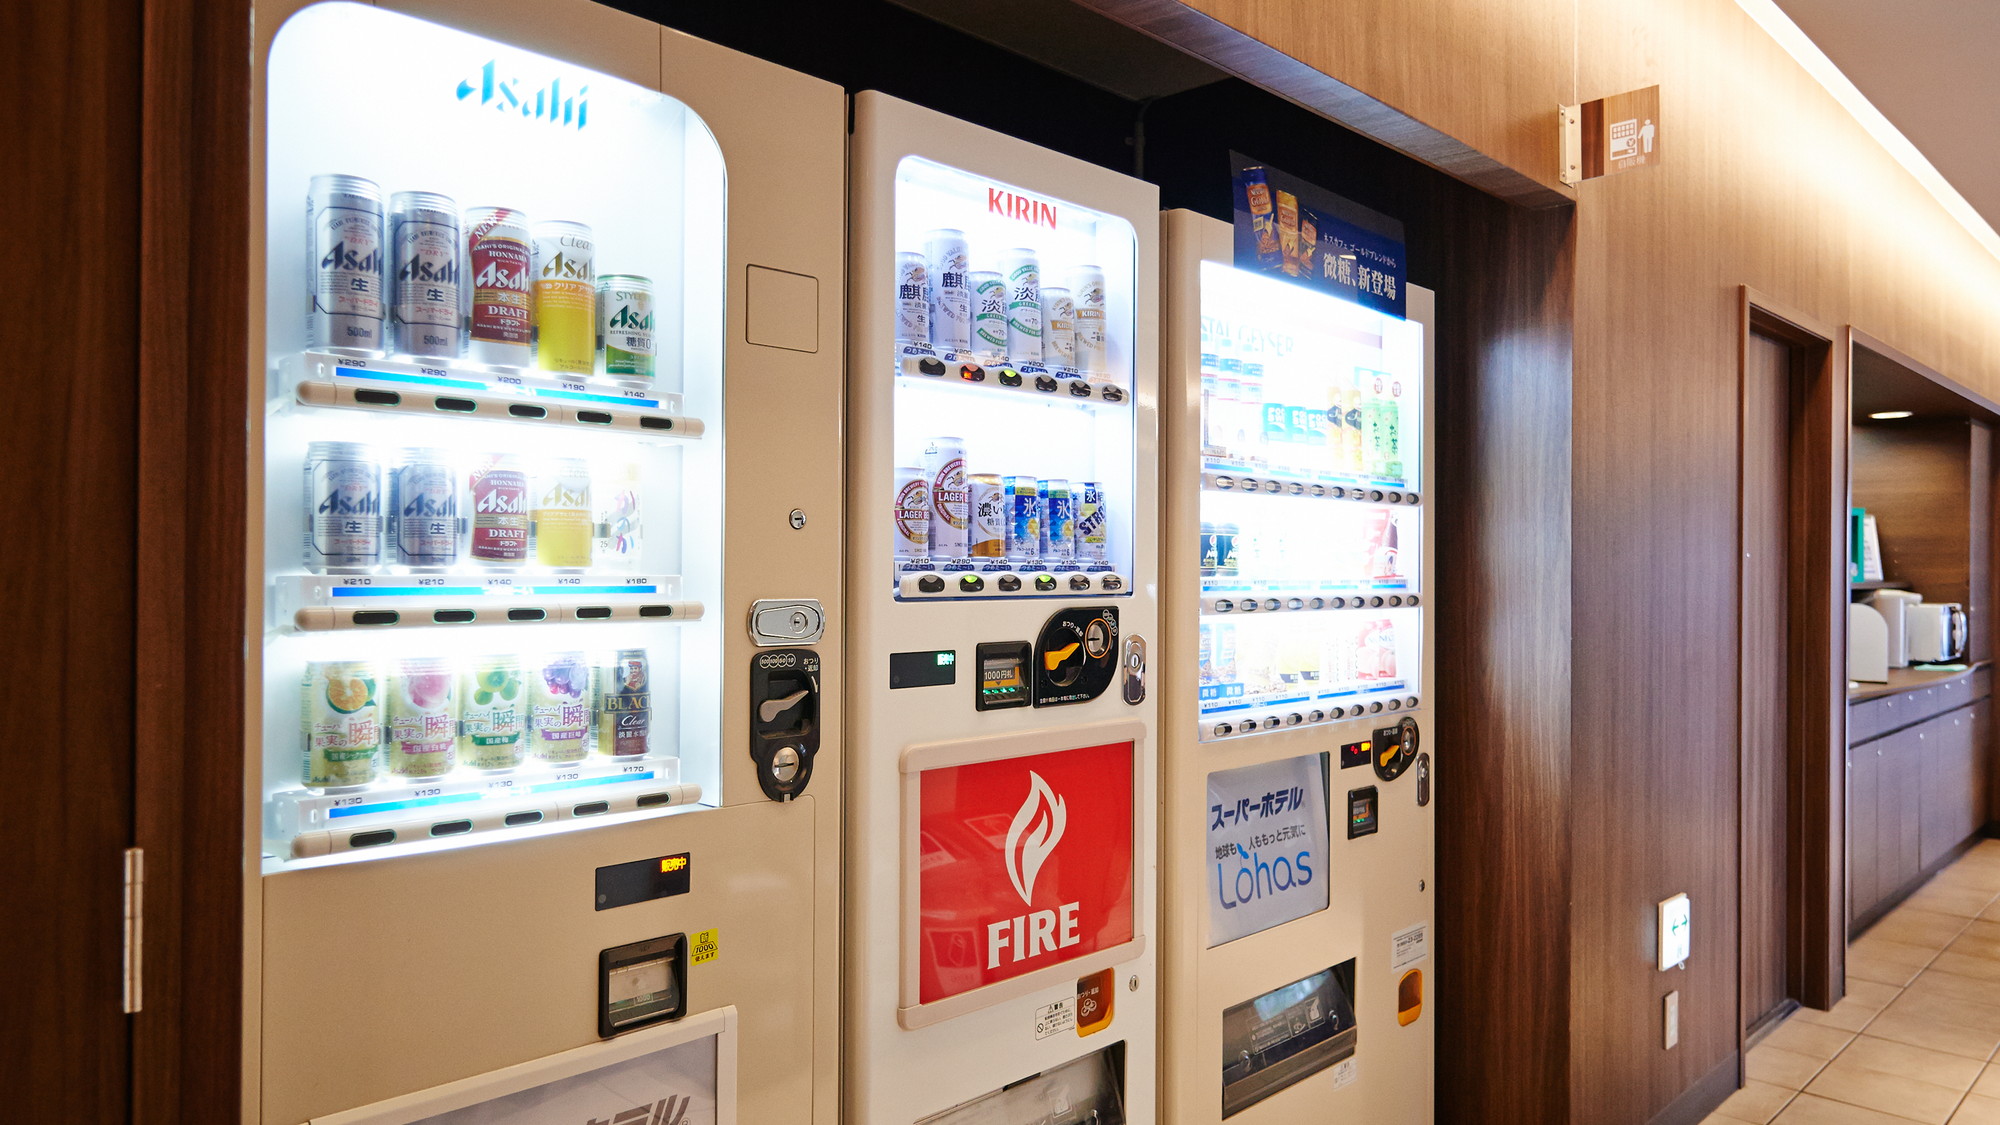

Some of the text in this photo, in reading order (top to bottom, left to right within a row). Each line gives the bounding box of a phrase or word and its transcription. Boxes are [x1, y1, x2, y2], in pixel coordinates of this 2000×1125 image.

[456, 59, 589, 131] Asahi
[988, 187, 1057, 230] KIRIN
[475, 216, 498, 239] NEW
[1324, 232, 1397, 269] ネスカフェ ゴールドブレンドから
[322, 241, 384, 275] Asah
[400, 253, 459, 285] Asah
[476, 261, 530, 293] Asah
[1323, 253, 1396, 301] 微糖、新登場
[351, 278, 369, 293] 生
[426, 288, 445, 302] 生
[497, 292, 520, 305] 本生
[488, 305, 528, 319] DRAFT
[959, 304, 967, 313] 生
[610, 304, 655, 332] Asah
[916, 314, 926, 323] 生
[913, 341, 933, 350] ¥140
[338, 358, 366, 368] ¥290
[1028, 360, 1045, 368] ¥200
[421, 367, 447, 377] ¥290
[1063, 366, 1079, 374] ¥210
[497, 375, 522, 385] ¥200
[562, 382, 585, 391] ¥190
[624, 390, 645, 398] ¥140
[319, 489, 380, 514] Asah
[477, 489, 527, 515] Asah
[938, 492, 964, 503] LAGER
[404, 493, 456, 517] Asah
[977, 502, 1004, 518] 濃い
[899, 510, 923, 519] LAGER
[345, 520, 362, 534] 生
[498, 516, 519, 527] 本生
[430, 523, 446, 535] 生
[489, 528, 526, 538] DRAFT
[343, 578, 372, 586] ¥210
[418, 578, 445, 586] ¥210
[487, 578, 512, 586] ¥140
[626, 577, 647, 585] ¥180
[803, 657, 819, 665] おつり
[984, 669, 1013, 681] 1000円札
[607, 696, 650, 710] BLAC
[621, 714, 646, 726] Clear
[623, 765, 644, 773] ¥170
[556, 773, 579, 781] ¥130
[488, 780, 513, 789] ¥130
[414, 788, 441, 797] ¥130
[334, 797, 363, 807] ¥130
[1211, 786, 1304, 831] スーパーホテル
[1215, 824, 1307, 860] 地球も 人ももっと元気に
[987, 901, 1080, 970] FIRE
[695, 942, 715, 954] 1000
[694, 952, 715, 963] 使えます
